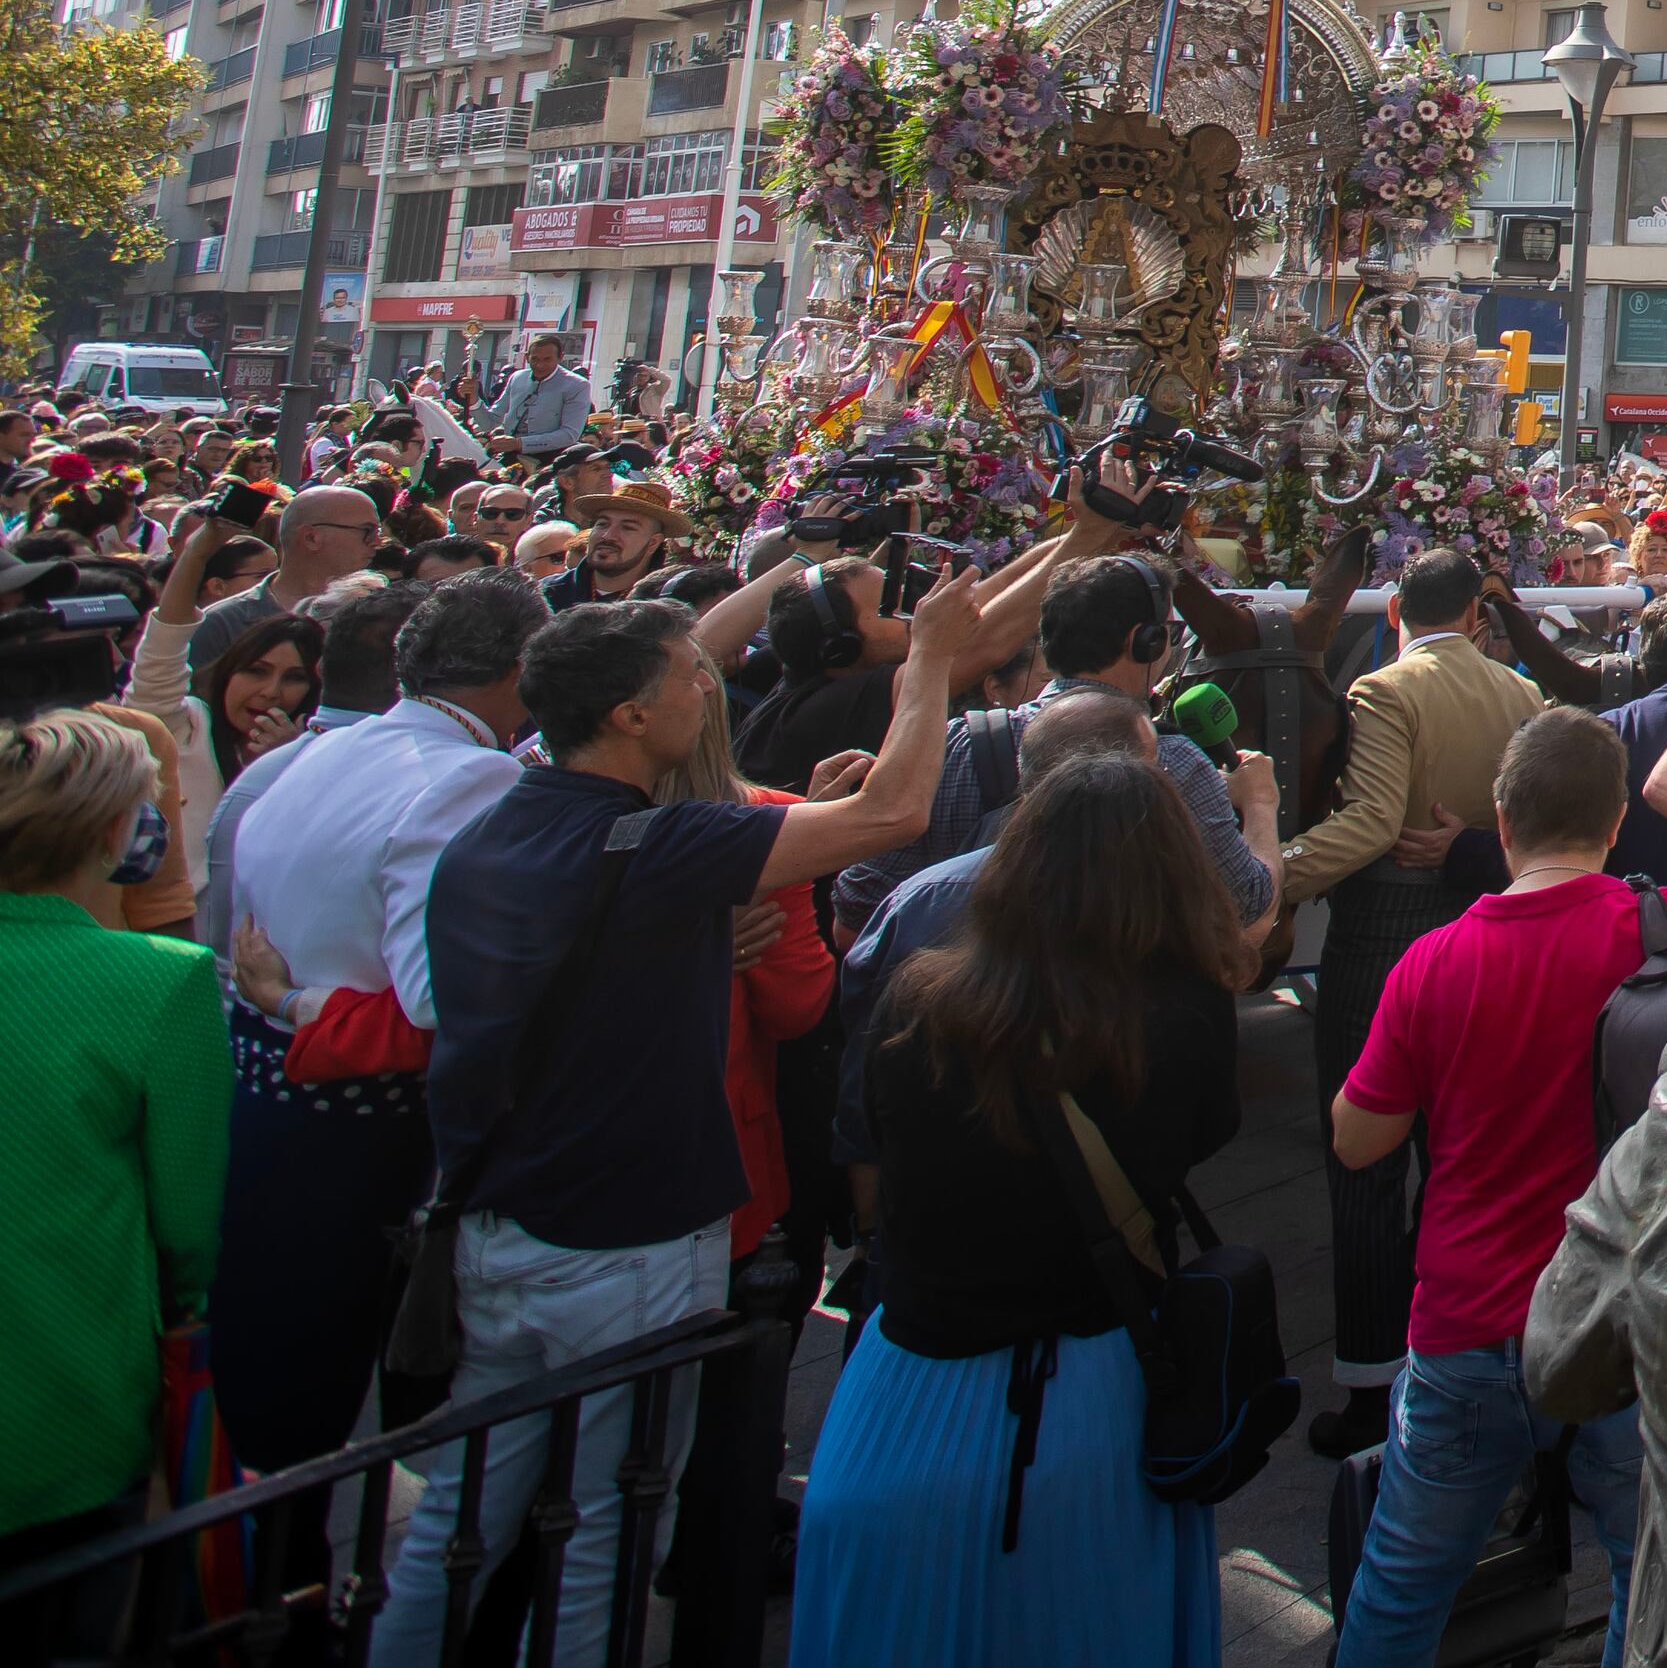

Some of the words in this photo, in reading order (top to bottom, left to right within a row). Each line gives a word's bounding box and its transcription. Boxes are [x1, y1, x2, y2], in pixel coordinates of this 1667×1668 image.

[700, 205, 708, 216] TU
[525, 211, 569, 229] ABOGADOS
[669, 218, 707, 233] PROPIEDAD
[465, 229, 499, 259] Quality
[422, 301, 454, 317] MAPFRE
[236, 367, 273, 378] SABOR
[1619, 408, 1647, 416] Catalana
